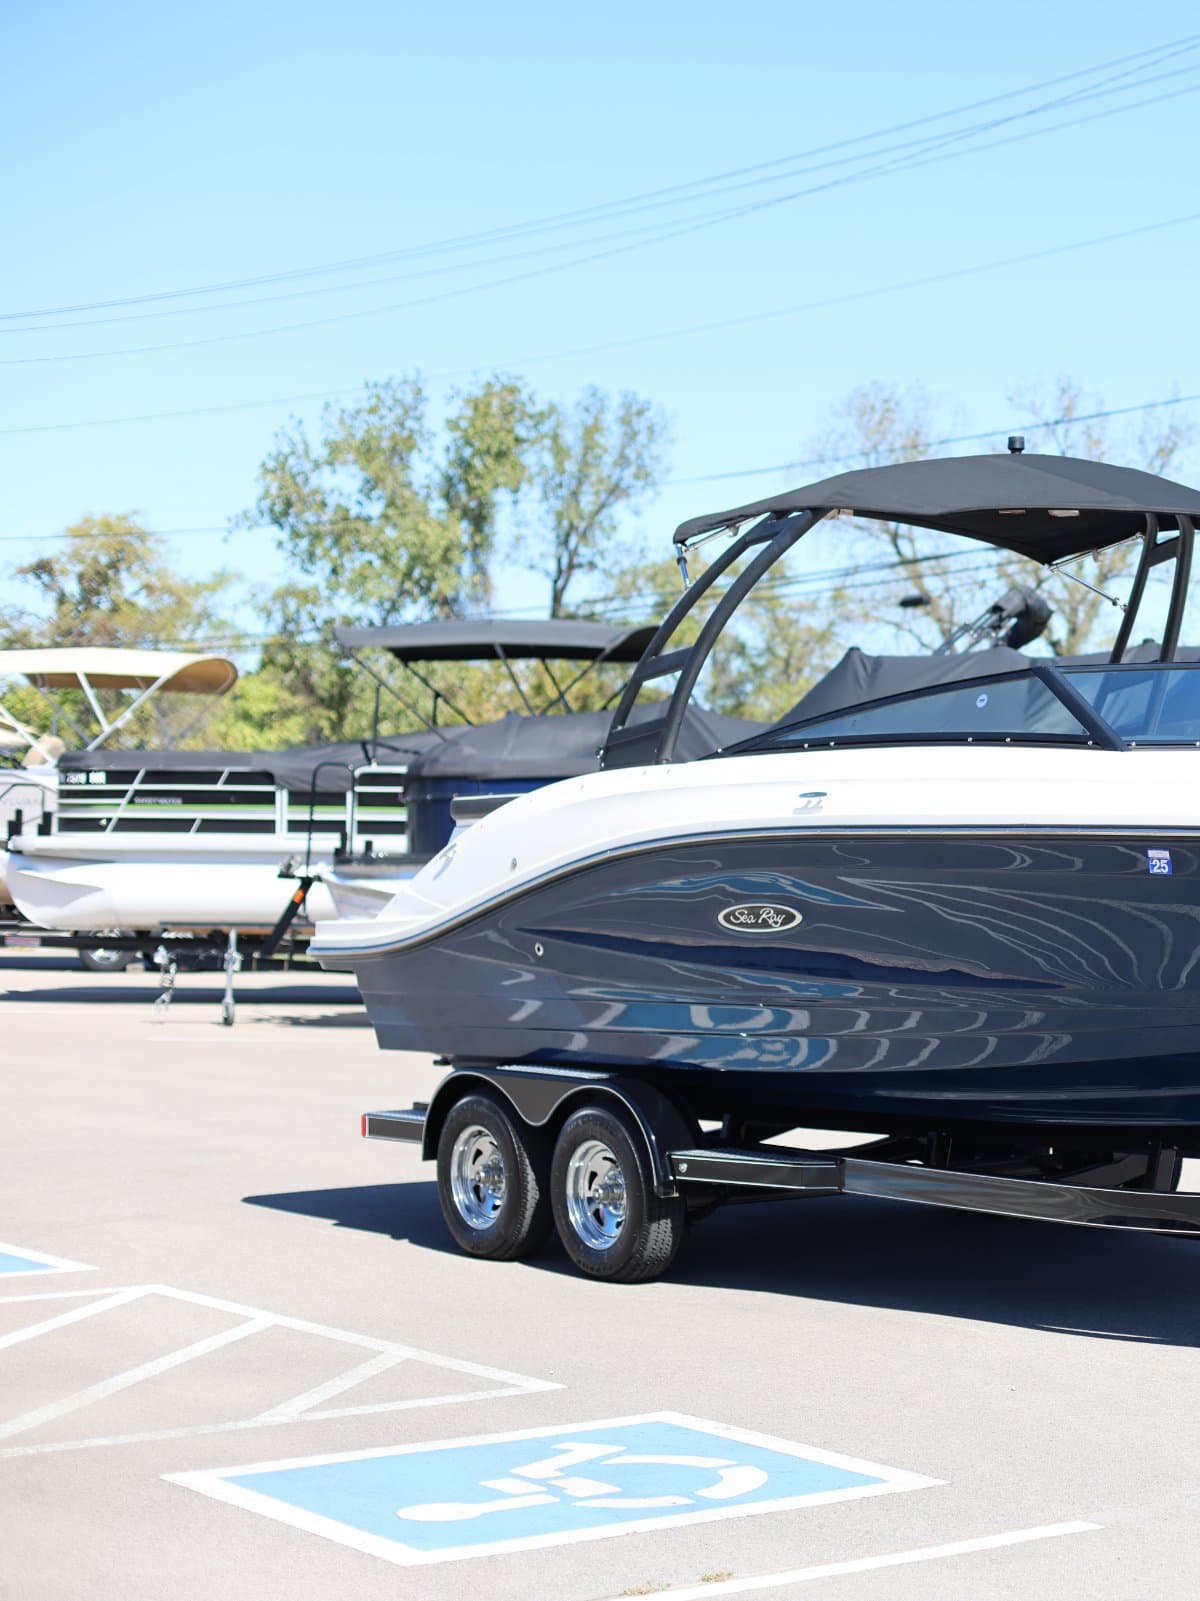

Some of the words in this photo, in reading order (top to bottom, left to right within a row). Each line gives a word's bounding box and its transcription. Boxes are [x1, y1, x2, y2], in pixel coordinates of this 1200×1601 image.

[1152, 859, 1169, 873] 25
[730, 909, 757, 924] Sea
[758, 907, 786, 928] Ray
